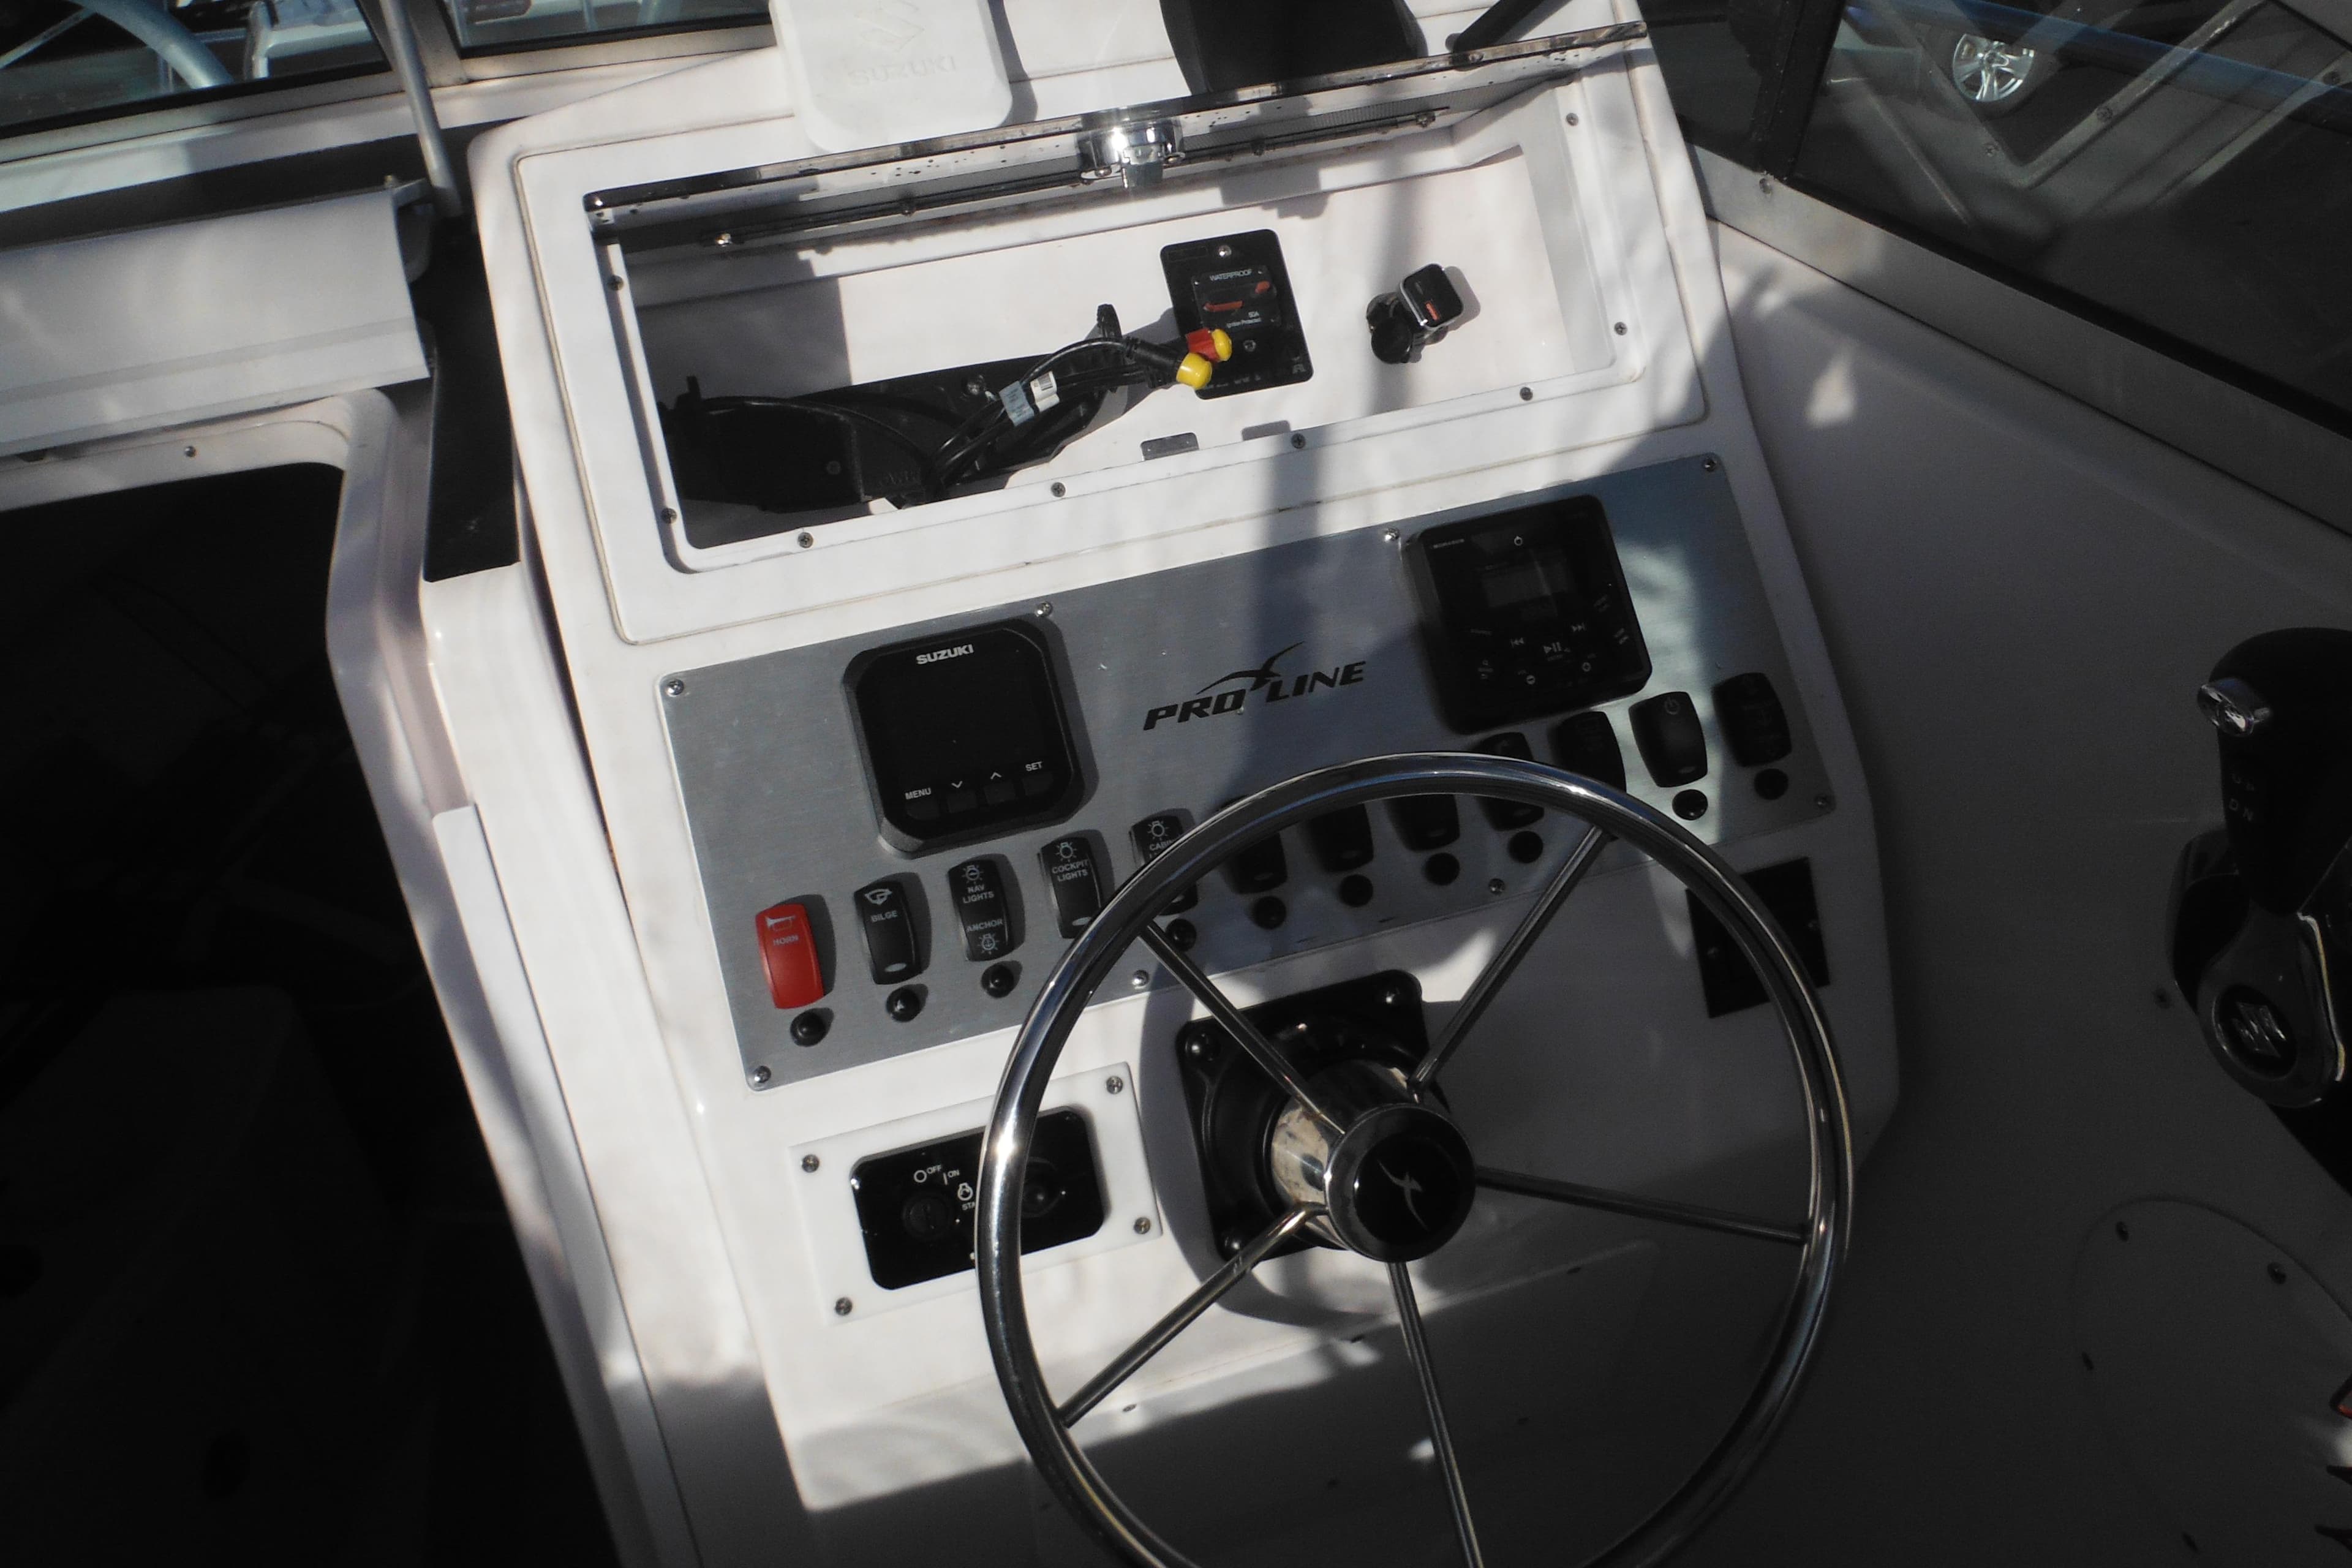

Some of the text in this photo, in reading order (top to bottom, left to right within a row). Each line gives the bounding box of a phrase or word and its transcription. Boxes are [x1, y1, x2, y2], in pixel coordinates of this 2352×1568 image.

[916, 643, 974, 665] SUZUKI
[1144, 661, 1366, 731] PRO LINE
[1025, 761, 1044, 772] SET
[905, 787, 932, 800] MENU
[1052, 859, 1088, 874] COCKPIT
[1057, 868, 1088, 882] LIGHTS
[967, 884, 986, 895] NAV
[963, 891, 995, 904] LIGHTS
[871, 910, 898, 923] BILGE
[967, 918, 1003, 933] ANCHOR
[772, 934, 799, 946] HORN
[926, 1164, 942, 1174] OFF
[947, 1169, 960, 1178] ON
[962, 1201, 976, 1211] STA
